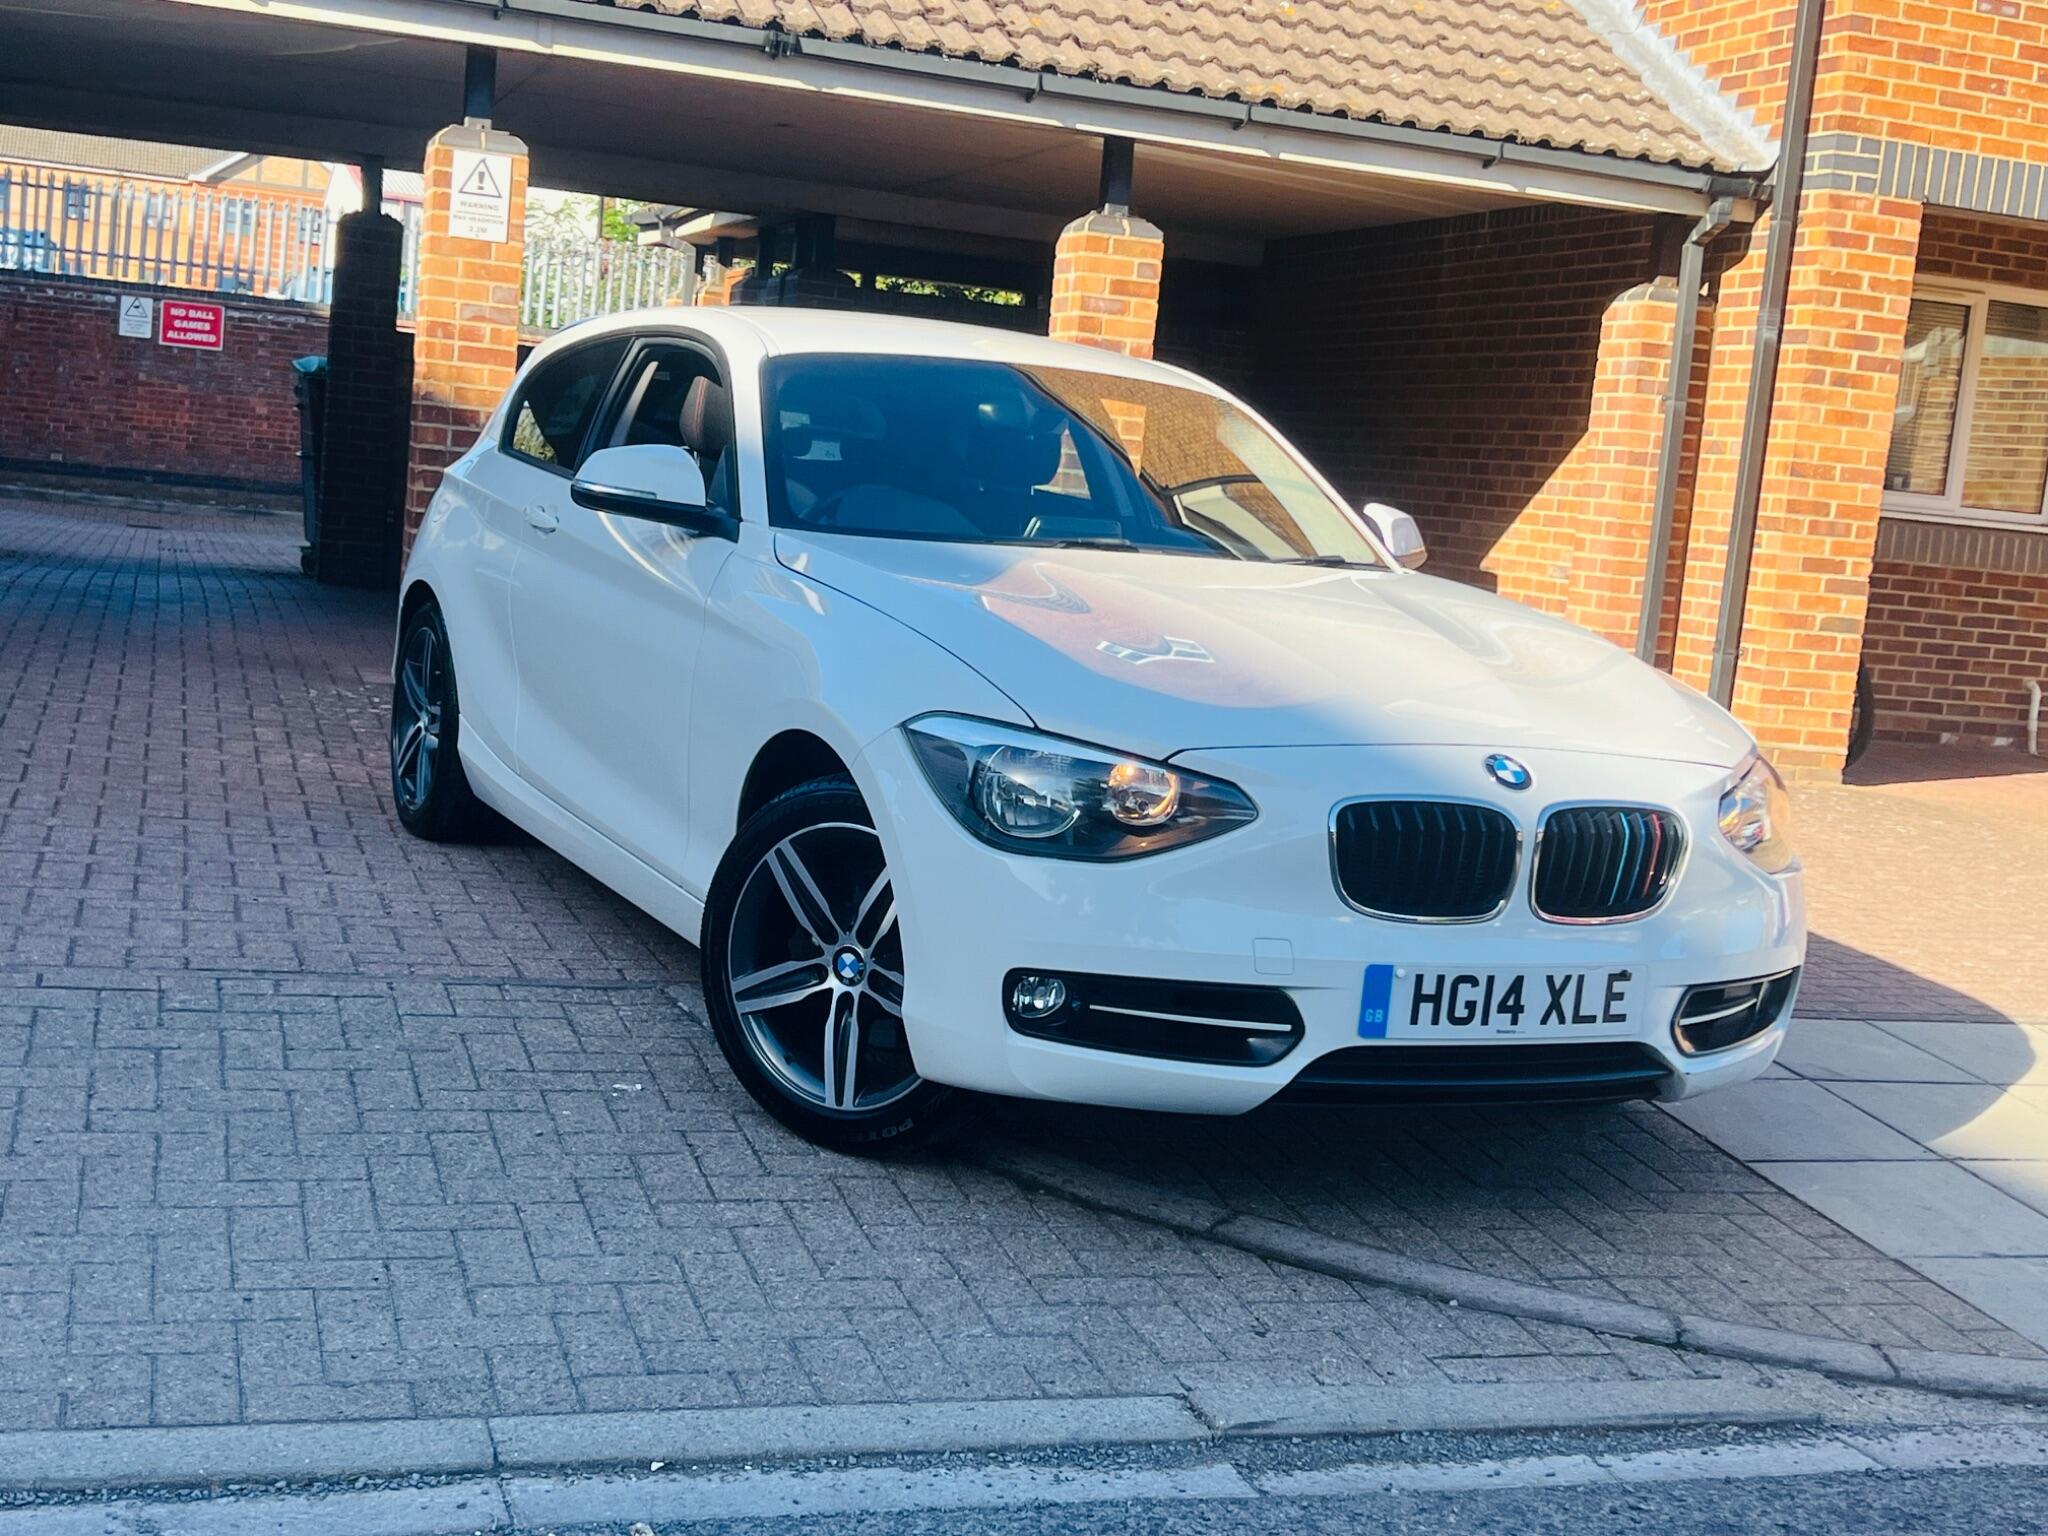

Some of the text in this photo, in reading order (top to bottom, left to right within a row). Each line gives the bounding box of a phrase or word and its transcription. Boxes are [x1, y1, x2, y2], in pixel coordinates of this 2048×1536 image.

[460, 201, 500, 211] WARNING
[170, 307, 216, 320] NO BALL
[173, 319, 211, 331] GAMES
[166, 330, 217, 343] ALLOWED
[1409, 972, 1632, 1026] HG14 XLE
[1364, 1008, 1384, 1023] GB
